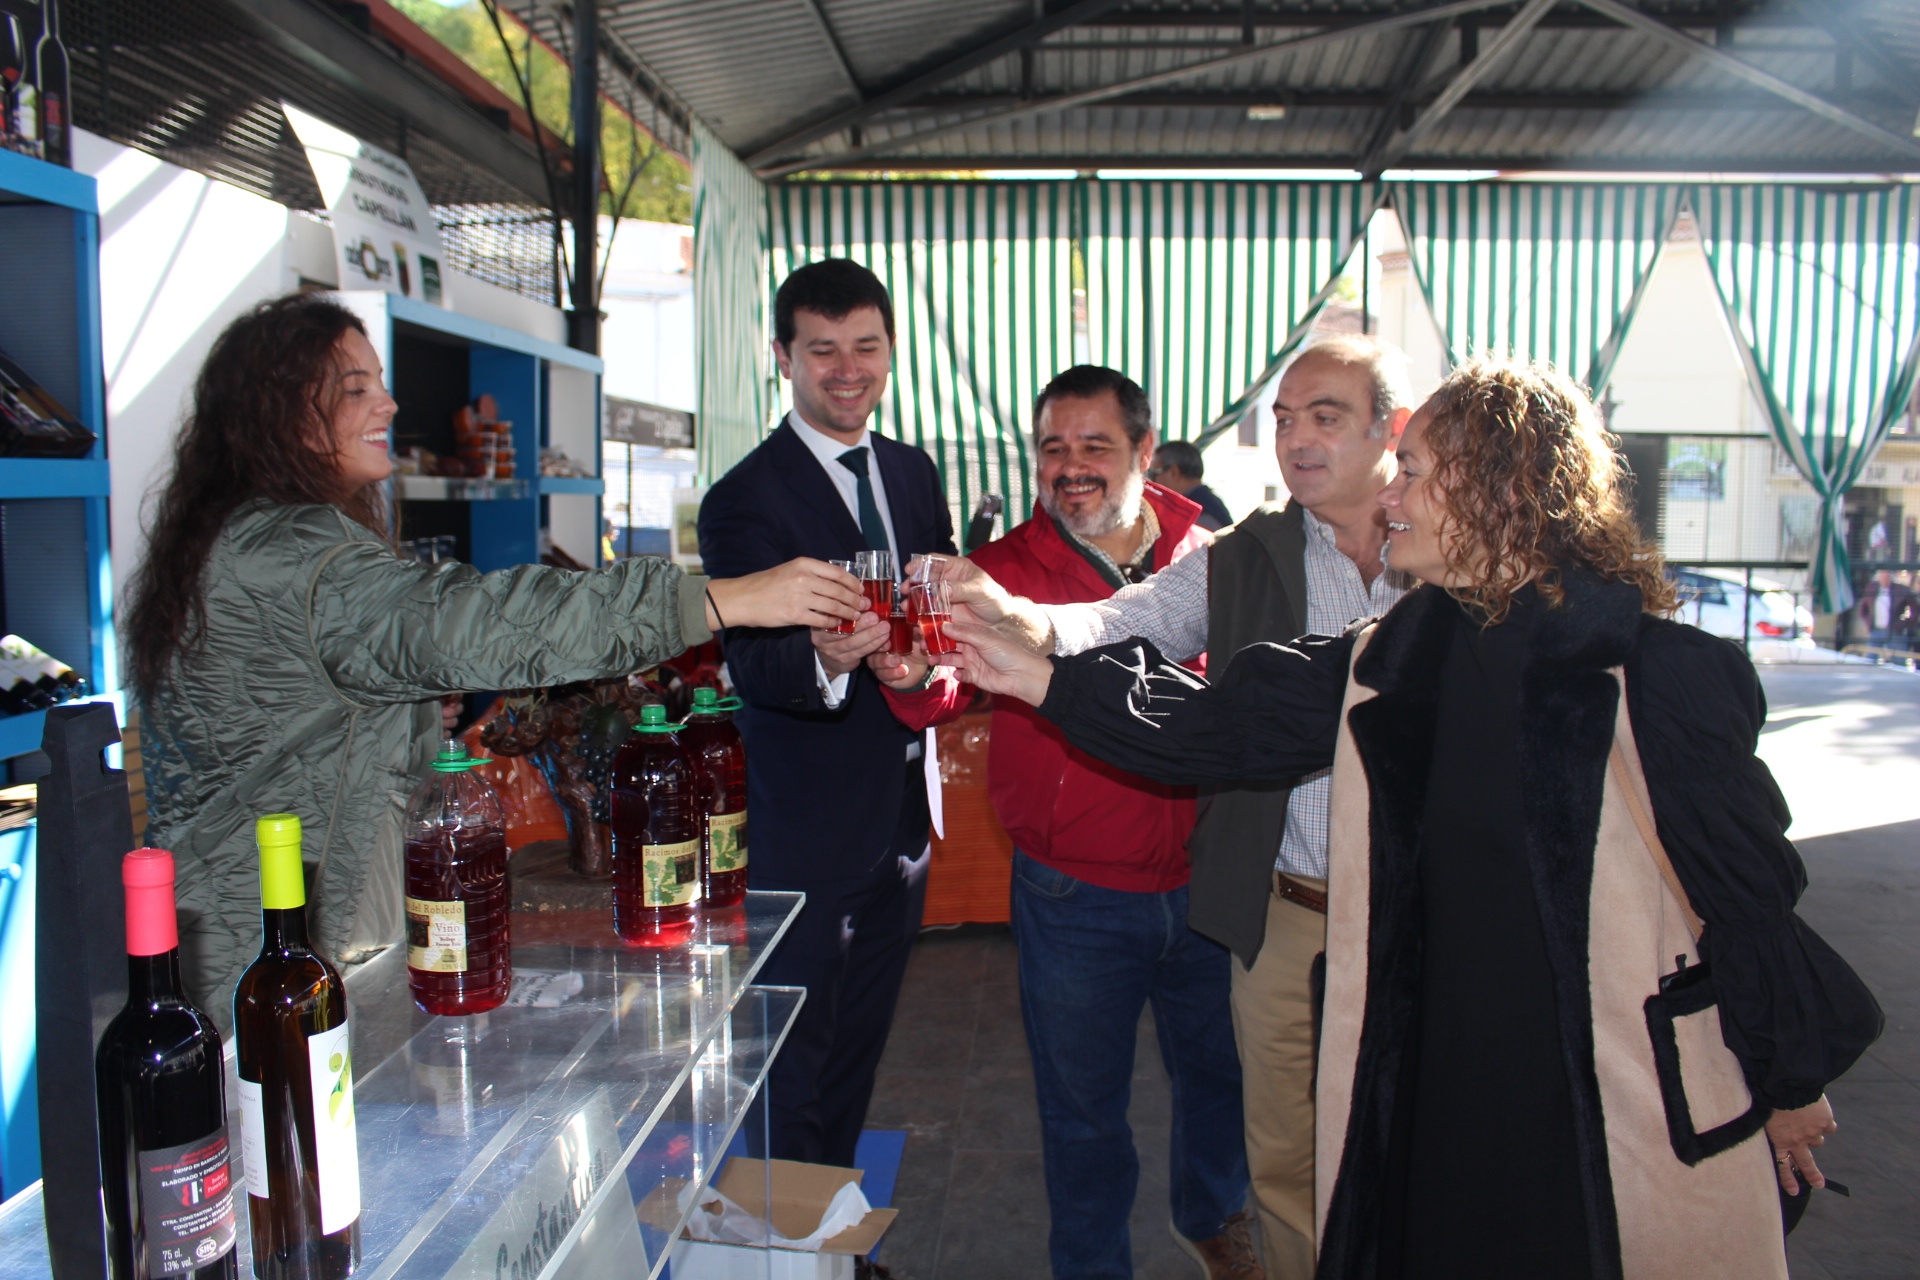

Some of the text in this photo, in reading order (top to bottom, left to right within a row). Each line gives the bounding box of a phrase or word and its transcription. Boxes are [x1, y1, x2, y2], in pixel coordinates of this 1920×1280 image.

[644, 848, 679, 857] Racimos
[423, 904, 462, 914] Robledo
[435, 922, 460, 933] Vino
[173, 1165, 193, 1175] TIEMPO
[161, 1173, 198, 1187] ELABORADO
[179, 1206, 213, 1223] CONSTANTINA
[173, 1215, 209, 1231] CONSTANTINA
[162, 1247, 183, 1260] 75 cl.
[164, 1260, 180, 1272] 13%
[181, 1257, 194, 1268] vol.
